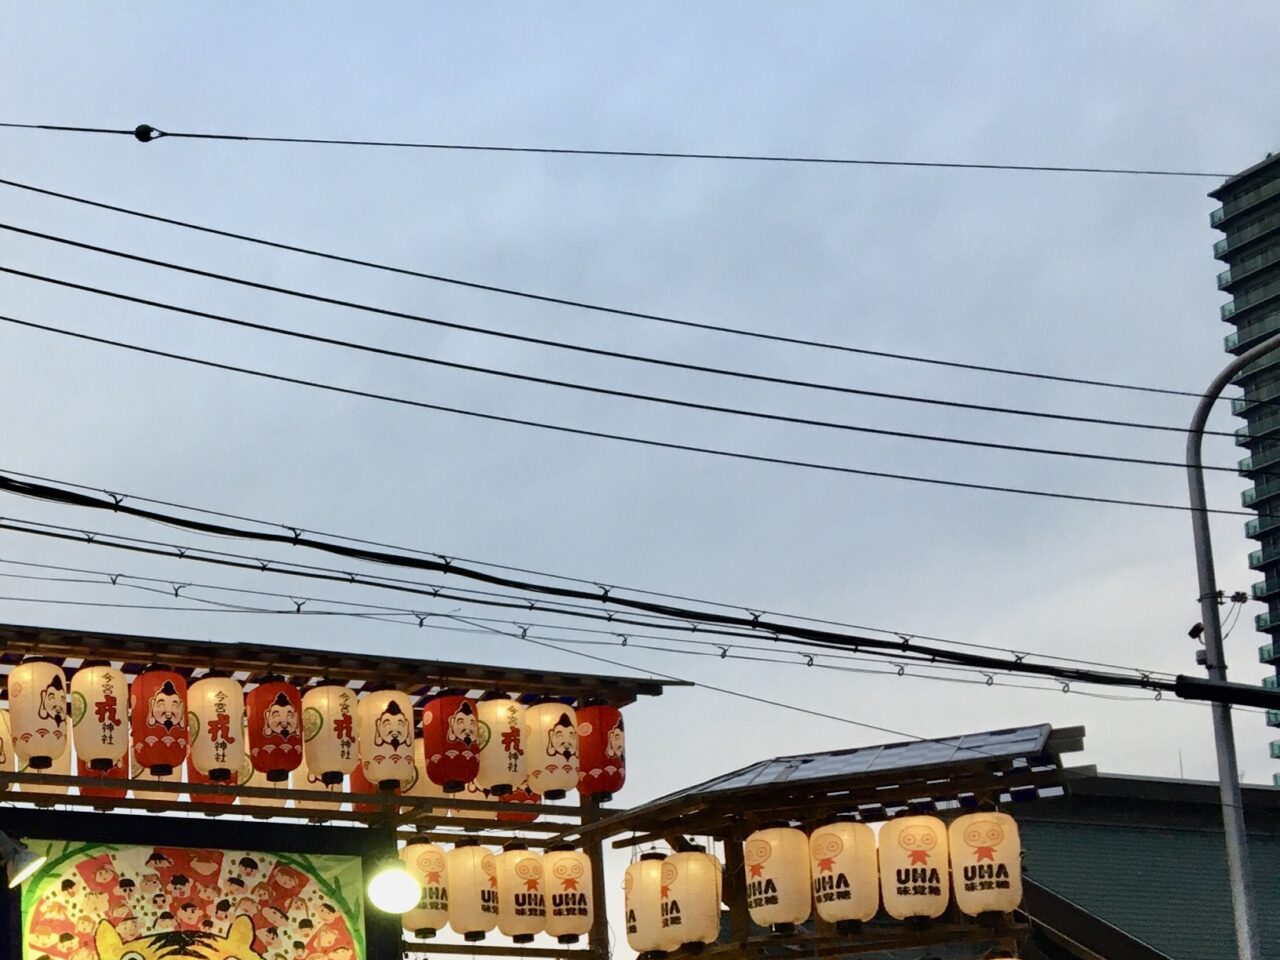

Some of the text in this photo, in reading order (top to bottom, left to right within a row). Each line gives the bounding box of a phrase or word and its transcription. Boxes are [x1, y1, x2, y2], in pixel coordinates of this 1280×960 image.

[95, 673, 122, 745] 今宮戎神社
[208, 691, 235, 763] 今宮戎神社
[333, 692, 356, 760] 今宮戎神社
[896, 867, 941, 885] UHA
[963, 863, 1010, 881] UHA
[552, 893, 587, 907] UHA
